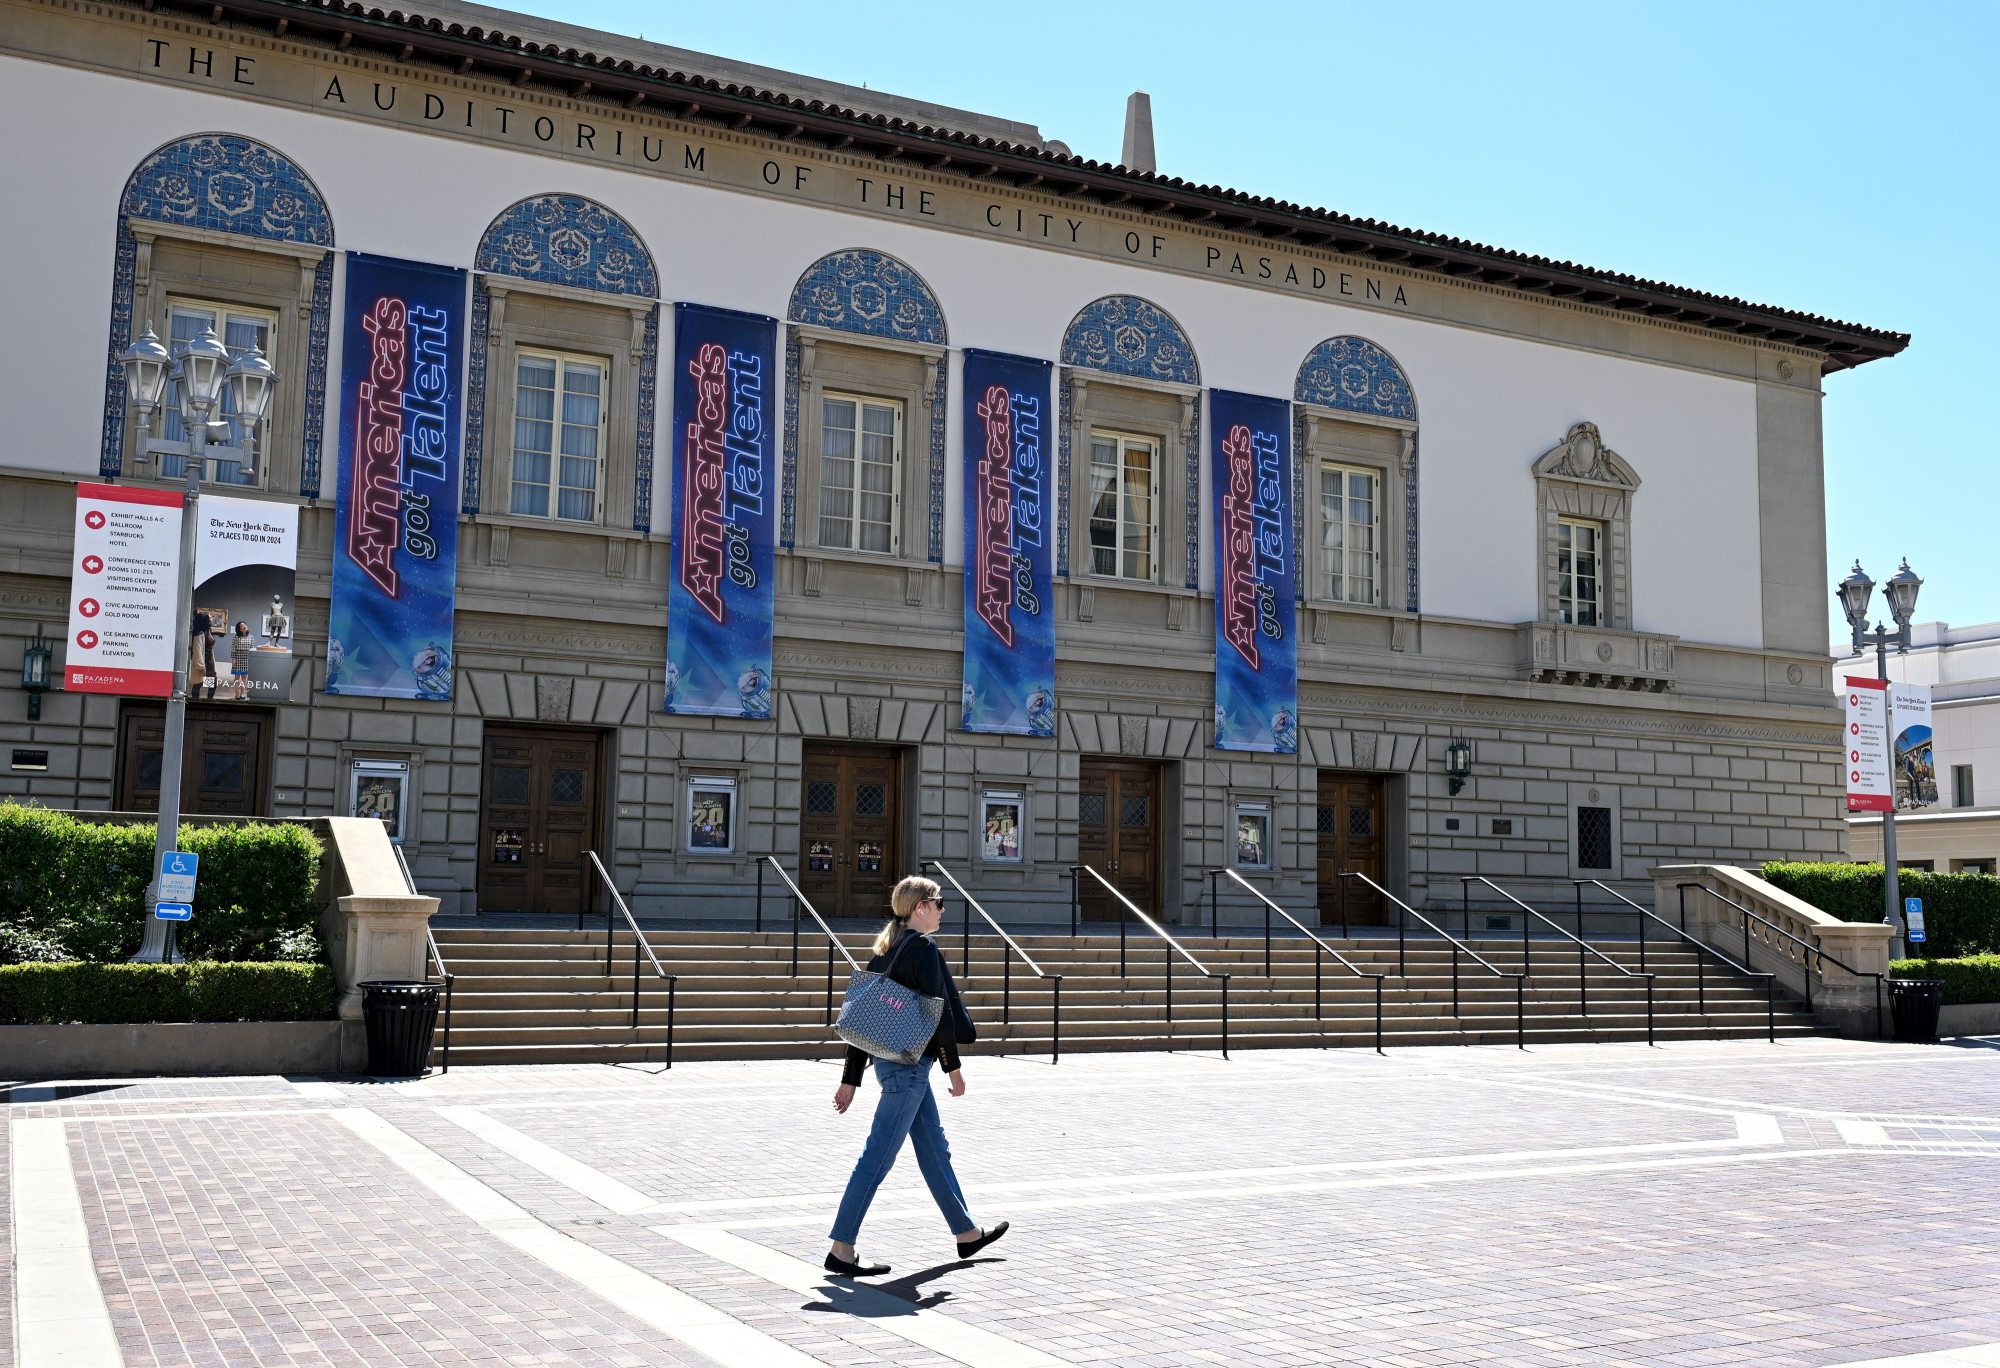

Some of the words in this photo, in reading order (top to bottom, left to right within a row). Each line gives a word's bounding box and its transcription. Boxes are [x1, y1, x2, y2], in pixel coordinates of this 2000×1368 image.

[146, 38, 256, 86] THE
[322, 75, 706, 172] AUDITORIUM
[762, 160, 812, 191] OF
[856, 178, 937, 216] THE
[985, 203, 1084, 243] CITY
[1124, 230, 1167, 259] OF
[1206, 246, 1409, 306] PASADENA
[400, 304, 448, 491] Talent
[723, 350, 763, 522] Talent
[348, 297, 406, 598] America's
[1010, 393, 1043, 550] Talent
[682, 343, 728, 624] America's
[1252, 431, 1285, 583] Talent
[111, 512, 134, 520] EXHIBIT
[135, 514, 154, 522] HALLS
[976, 386, 1012, 648] America's
[110, 521, 143, 530] BALLROOM
[210, 518, 225, 528] The
[226, 520, 242, 530] New
[242, 521, 262, 533] York
[262, 523, 286, 534] Times
[401, 489, 440, 561] got
[109, 530, 144, 539] STARBUCKS
[210, 530, 218, 538] 52
[218, 531, 241, 541] PLACES
[242, 533, 249, 541] TO
[250, 534, 259, 542] GO
[259, 534, 266, 543] IN
[266, 535, 281, 545] 2024
[1223, 424, 1258, 670] America's
[108, 556, 147, 566] CONFERENCE
[147, 560, 171, 568] CENTER
[724, 524, 756, 588] got
[107, 566, 130, 574] ROOMS
[107, 575, 134, 583] VISITORS
[134, 577, 158, 585] CENTER
[1011, 553, 1040, 616] got
[106, 584, 156, 594] ADMINISTRATION
[122, 603, 159, 611] AUDITORIUM
[1256, 583, 1282, 640] got
[104, 611, 121, 619] GOLD
[121, 612, 140, 620] ROOM
[113, 631, 139, 640] SKATING
[139, 633, 163, 641] CENTER
[102, 640, 129, 648] PARKING
[102, 650, 135, 658] ELEVATORS
[84, 675, 124, 683] PASADENA
[216, 679, 279, 691] PASADENA
[358, 793, 395, 814] 20
[692, 807, 724, 827] 20
[986, 818, 1014, 836] 20
[496, 834, 508, 844] 20
[810, 845, 821, 854] 20
[859, 845, 869, 854] 20
